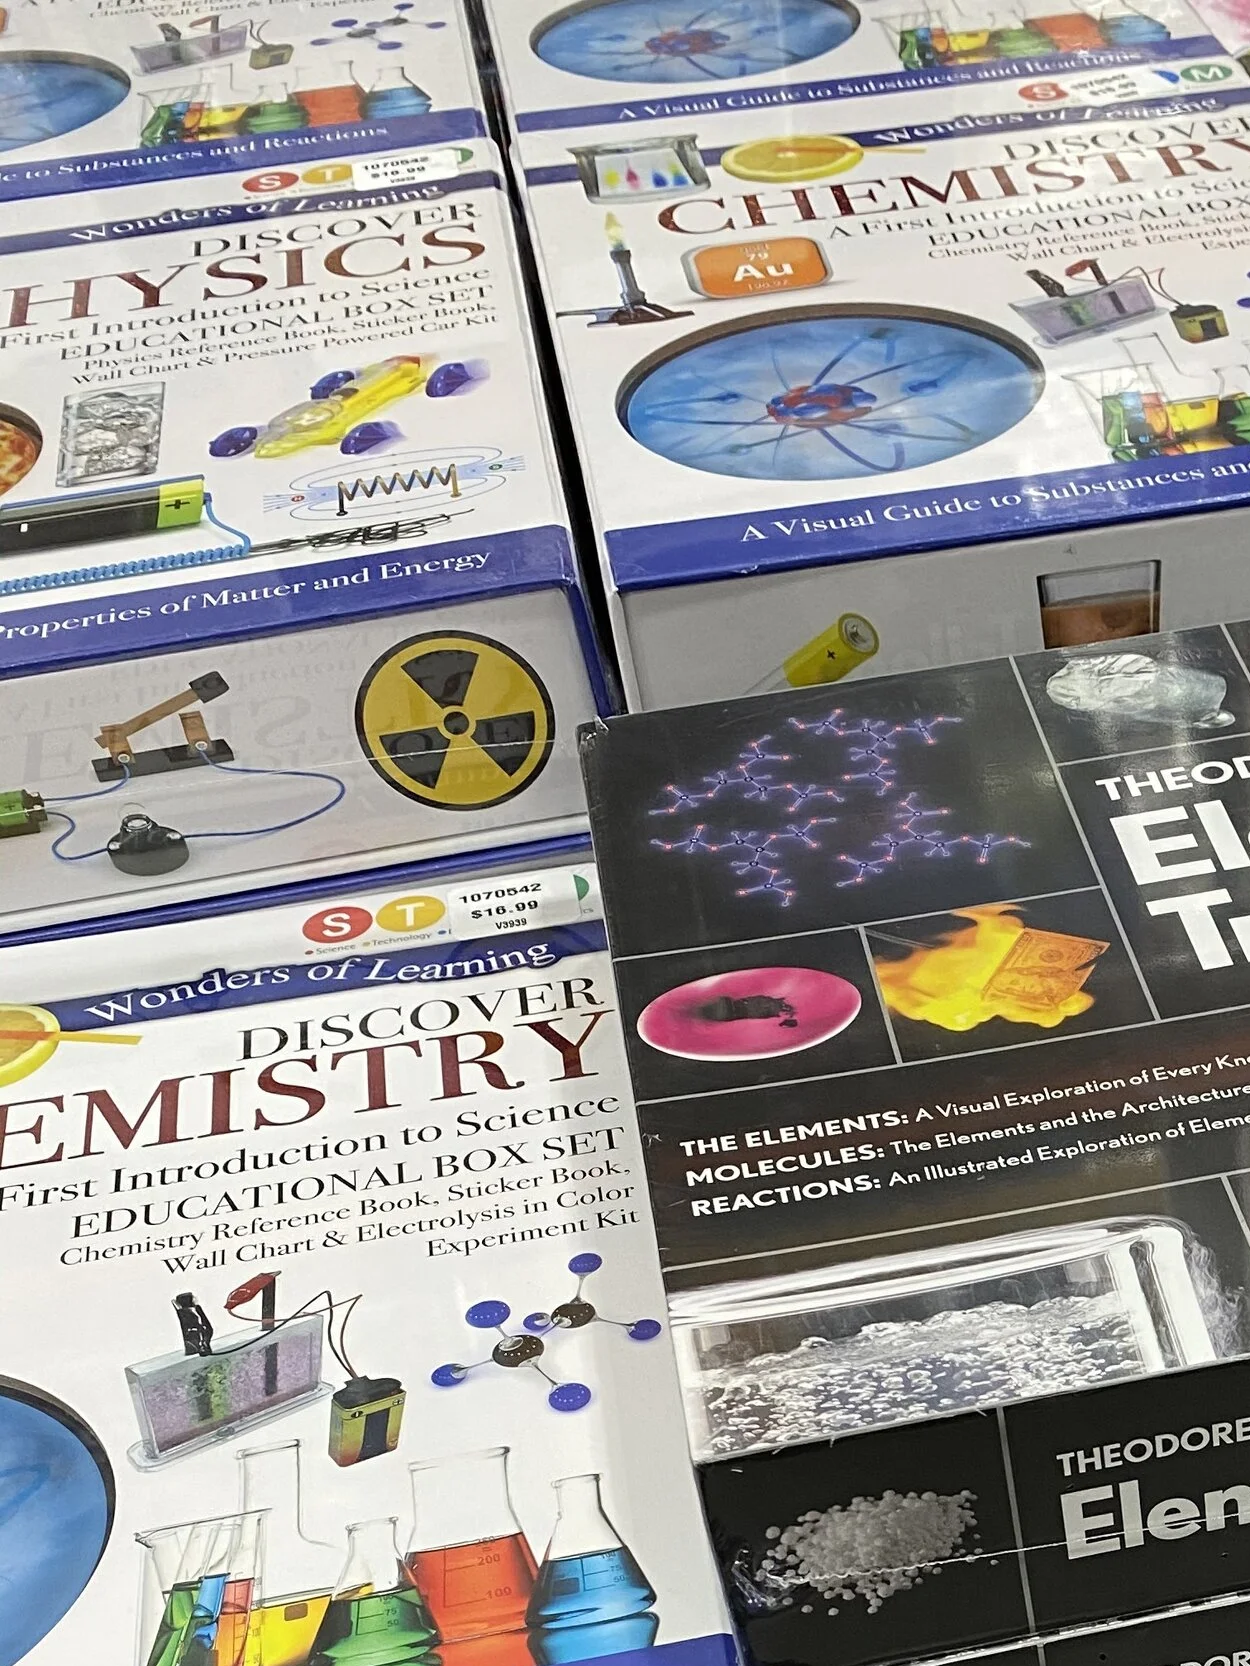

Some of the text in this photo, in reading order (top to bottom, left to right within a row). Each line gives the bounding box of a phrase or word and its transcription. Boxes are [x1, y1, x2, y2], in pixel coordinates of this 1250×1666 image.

[190, 202, 482, 257] DISCOVER
[929, 206, 1181, 247] EDUCATIONAL
[733, 260, 795, 282] Au
[0, 269, 490, 350] First Introduction to Science
[84, 350, 162, 370] Physics
[171, 334, 278, 358] Reference
[352, 313, 428, 332] Sticker
[741, 524, 767, 543] A
[772, 508, 877, 539] Visual
[883, 497, 981, 522] Guide
[985, 492, 1021, 509] to
[1031, 467, 1205, 503] Substances
[163, 592, 198, 617] of
[201, 578, 306, 609] Matter
[313, 566, 372, 590] and
[379, 549, 491, 586] Energy
[459, 883, 542, 904] 1070542
[471, 900, 539, 919] $16.99
[495, 918, 527, 930] V3939
[84, 941, 556, 1023] Wonders of Learning
[236, 977, 605, 1061] DISCOVER
[680, 1134, 738, 1157] THE
[745, 1109, 910, 1148] ELEMENTS:
[915, 1107, 934, 1123] A
[935, 1095, 1000, 1118] Visual
[1004, 1077, 1126, 1107] Exploration
[1129, 1069, 1151, 1086] of
[1152, 1059, 1213, 1082] Every
[685, 1143, 886, 1187] MOLECULES:
[889, 1139, 932, 1156] The
[935, 1121, 1035, 1149] Elements
[1039, 1112, 1078, 1131] and
[1081, 1108, 1117, 1124] the
[691, 1174, 882, 1217] REACTIONS:
[888, 1171, 921, 1187] An
[924, 1149, 1034, 1181] Illustrated
[1037, 1129, 1162, 1161] Exploration
[1165, 1123, 1187, 1139] of
[60, 1159, 631, 1266] Chemistry Reference Book, Sticker Book,
[426, 1208, 641, 1258] Experiment Kit
[476, 1553, 501, 1567] 200
